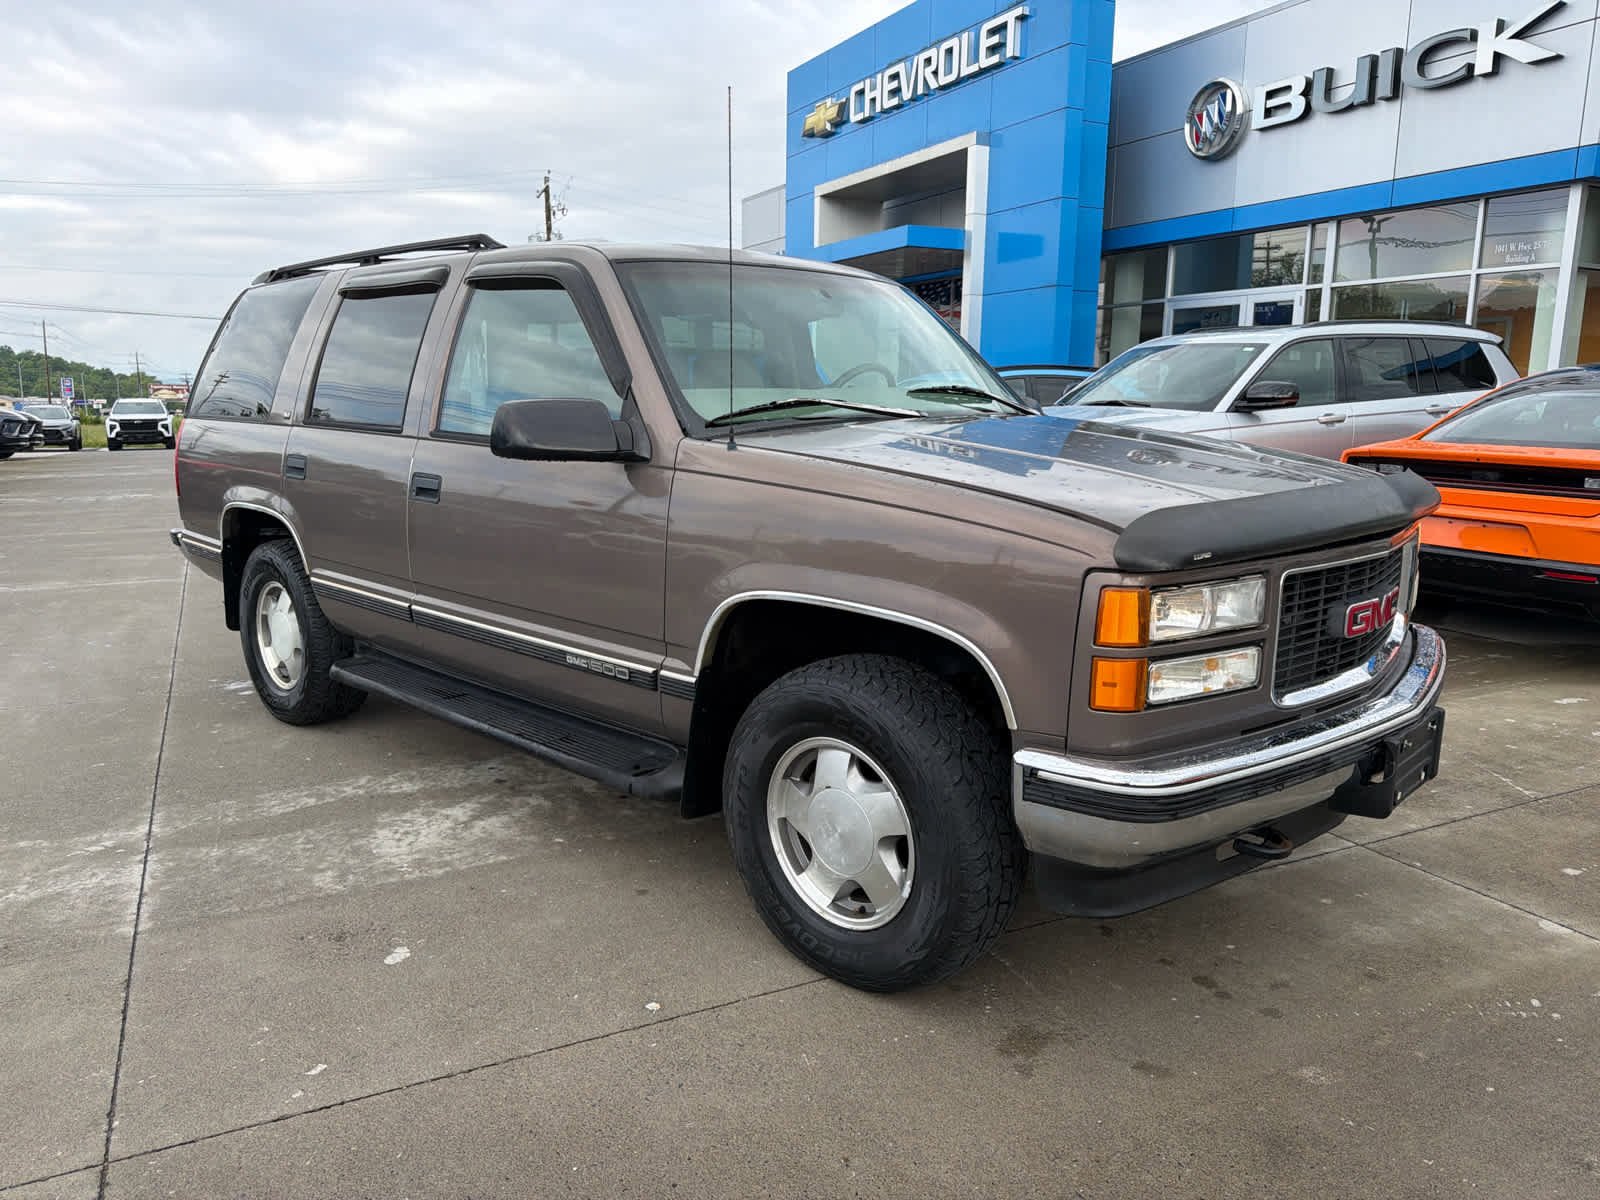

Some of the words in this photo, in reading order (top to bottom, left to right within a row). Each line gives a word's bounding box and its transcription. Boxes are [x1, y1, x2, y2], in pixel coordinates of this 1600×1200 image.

[849, 6, 1029, 124] CHEVROLET
[1251, 0, 1567, 131] BUICK
[1345, 586, 1399, 638] GMC
[566, 655, 588, 668] GMC
